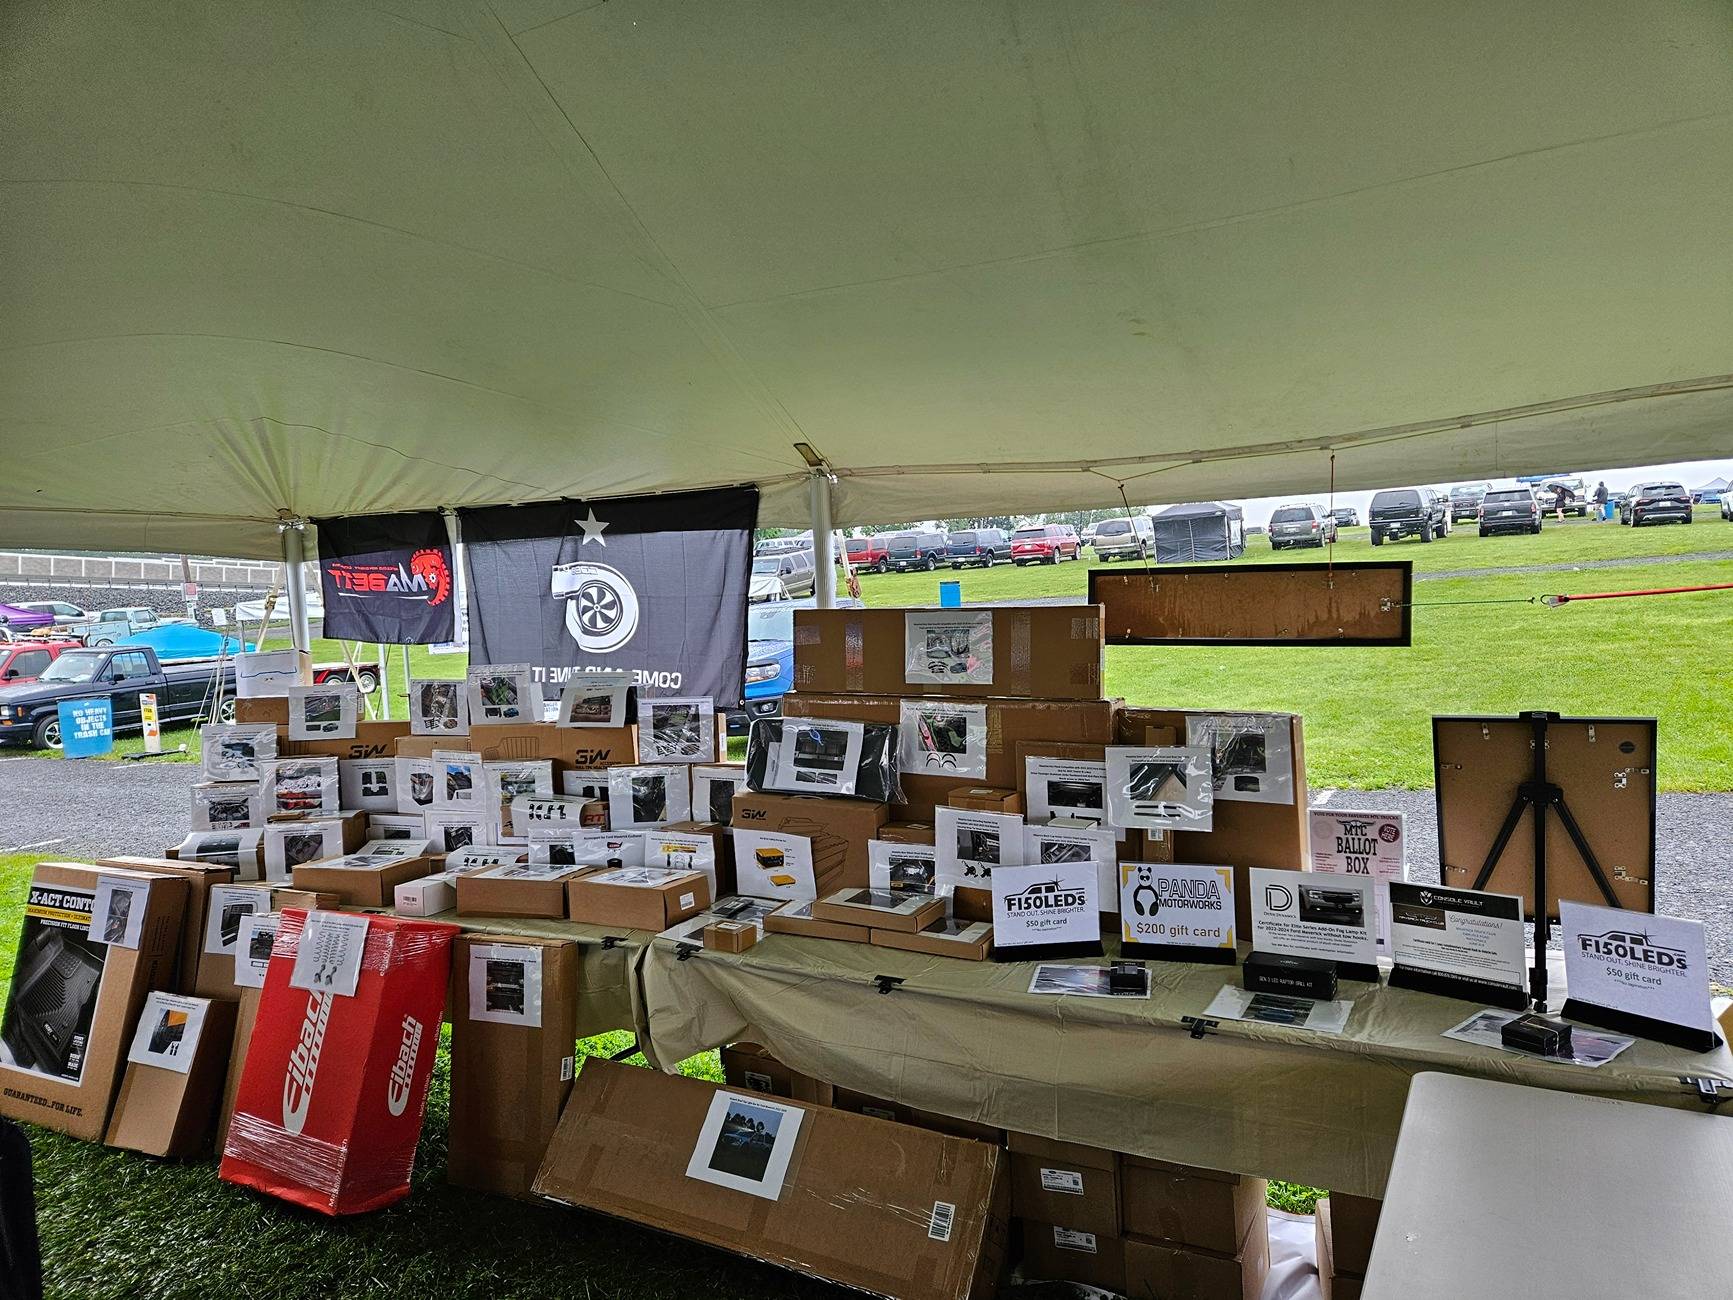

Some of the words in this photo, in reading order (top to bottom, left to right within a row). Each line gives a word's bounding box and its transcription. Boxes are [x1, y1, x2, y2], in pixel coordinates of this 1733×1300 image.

[85, 708, 107, 716] HEAVY
[76, 715, 106, 724] OBJECTS
[74, 730, 98, 739] TRASH
[1344, 824, 1367, 836] MTC
[1336, 836, 1378, 856] BALLOT
[1346, 856, 1370, 874] BOX
[1158, 878, 1221, 900] PANDA
[30, 890, 62, 906] X-ACT
[1159, 898, 1222, 910] MOTORWORKS
[1007, 910, 1026, 918] STAND
[1040, 908, 1056, 916] SHINE
[1058, 906, 1086, 914] BRIGHTER.
[1026, 920, 1038, 928] $50
[1040, 919, 1051, 928] gift
[1052, 918, 1068, 926] card
[1137, 922, 1165, 934] $200
[1170, 924, 1188, 938] gift
[1193, 927, 1220, 938] card
[1582, 951, 1605, 962] STAND
[1606, 957, 1623, 966] OUT.
[1624, 960, 1646, 970] SHINE
[1648, 965, 1687, 978] BRIGHTER.
[1606, 966, 1622, 977] $50
[1624, 971, 1640, 982] gift
[1642, 974, 1662, 986] card
[388, 1014, 417, 1117] Eibach
[65, 1105, 82, 1117] LIFE.
